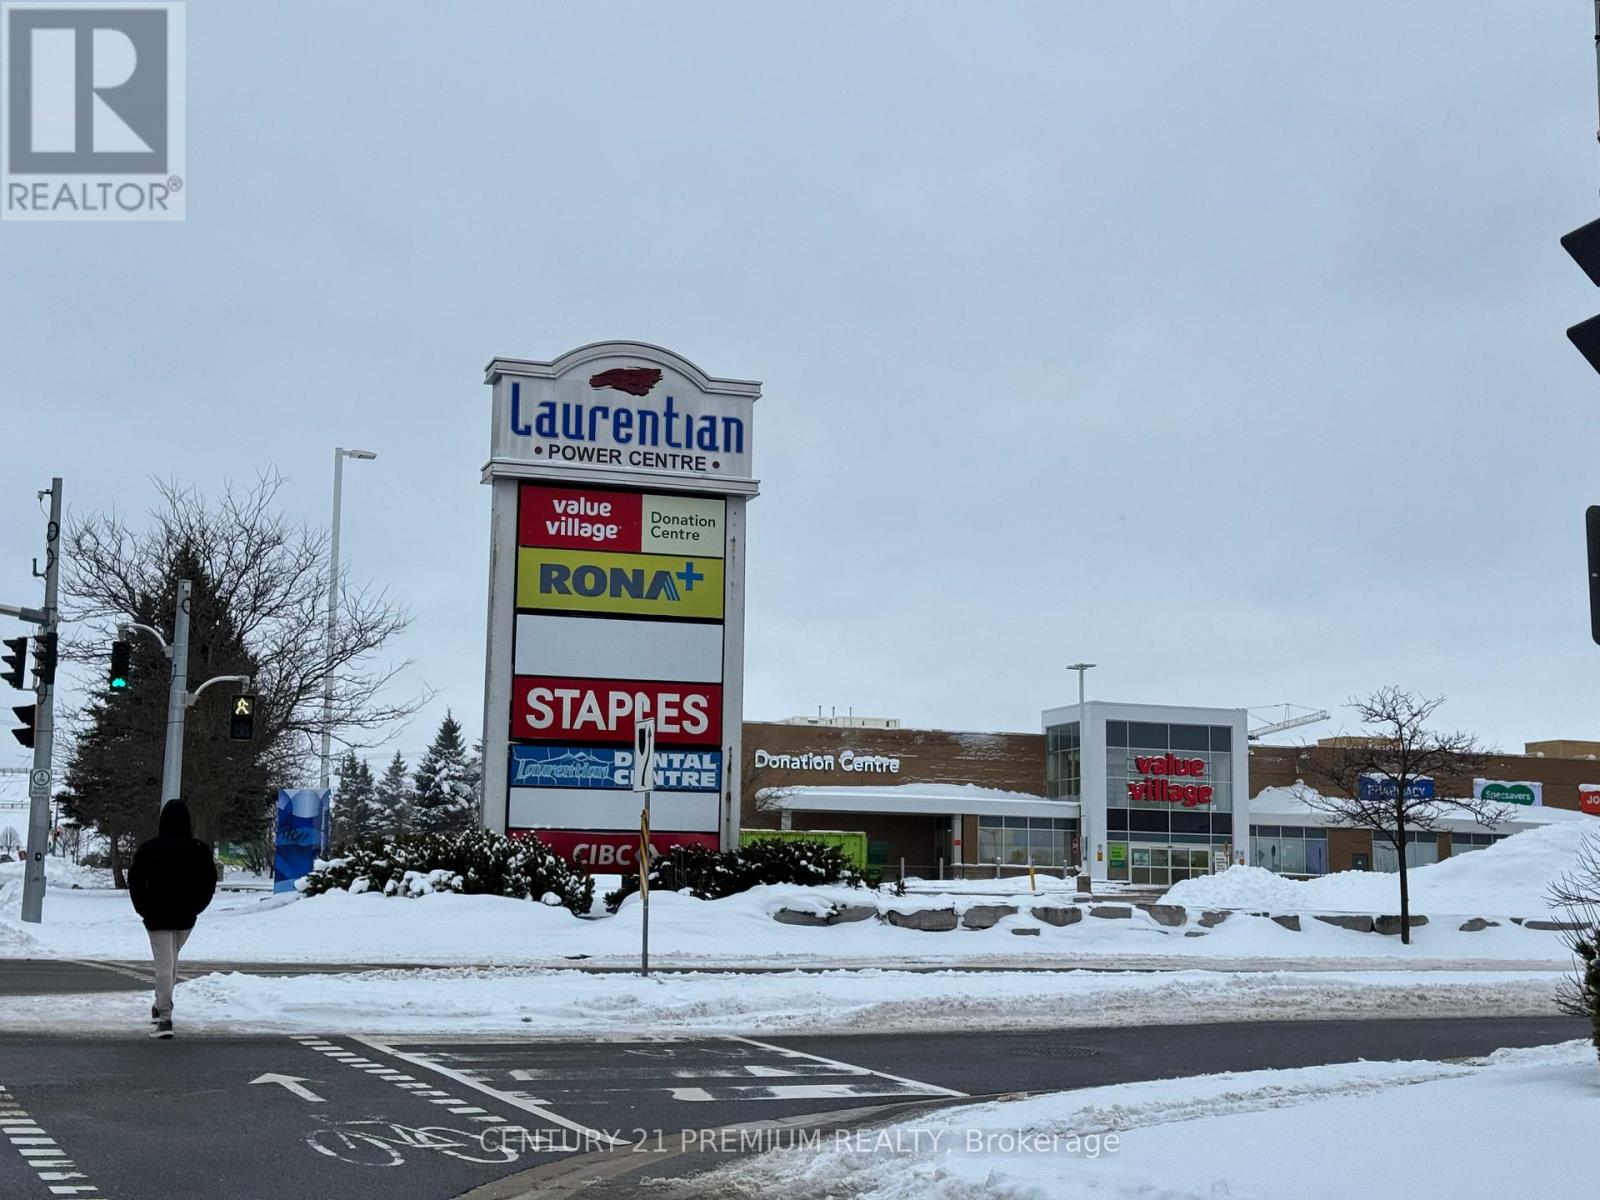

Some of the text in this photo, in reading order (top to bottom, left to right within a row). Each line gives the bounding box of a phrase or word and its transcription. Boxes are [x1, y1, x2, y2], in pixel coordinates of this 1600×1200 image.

[511, 382, 744, 453] Laurentian
[549, 444, 707, 471] POWER CENTRE
[553, 496, 612, 517] value
[546, 516, 618, 541] village
[651, 511, 716, 528] Donation
[651, 525, 700, 541] Centre
[517, 758, 610, 779] Laurentian
[613, 751, 716, 770] DNTAL
[755, 750, 900, 773] Donation Centre
[1135, 752, 1205, 777] value
[613, 769, 716, 787] CNTRE
[1127, 776, 1213, 808] village
[1485, 790, 1531, 801] Specsavers
[572, 843, 632, 866] CIBC
